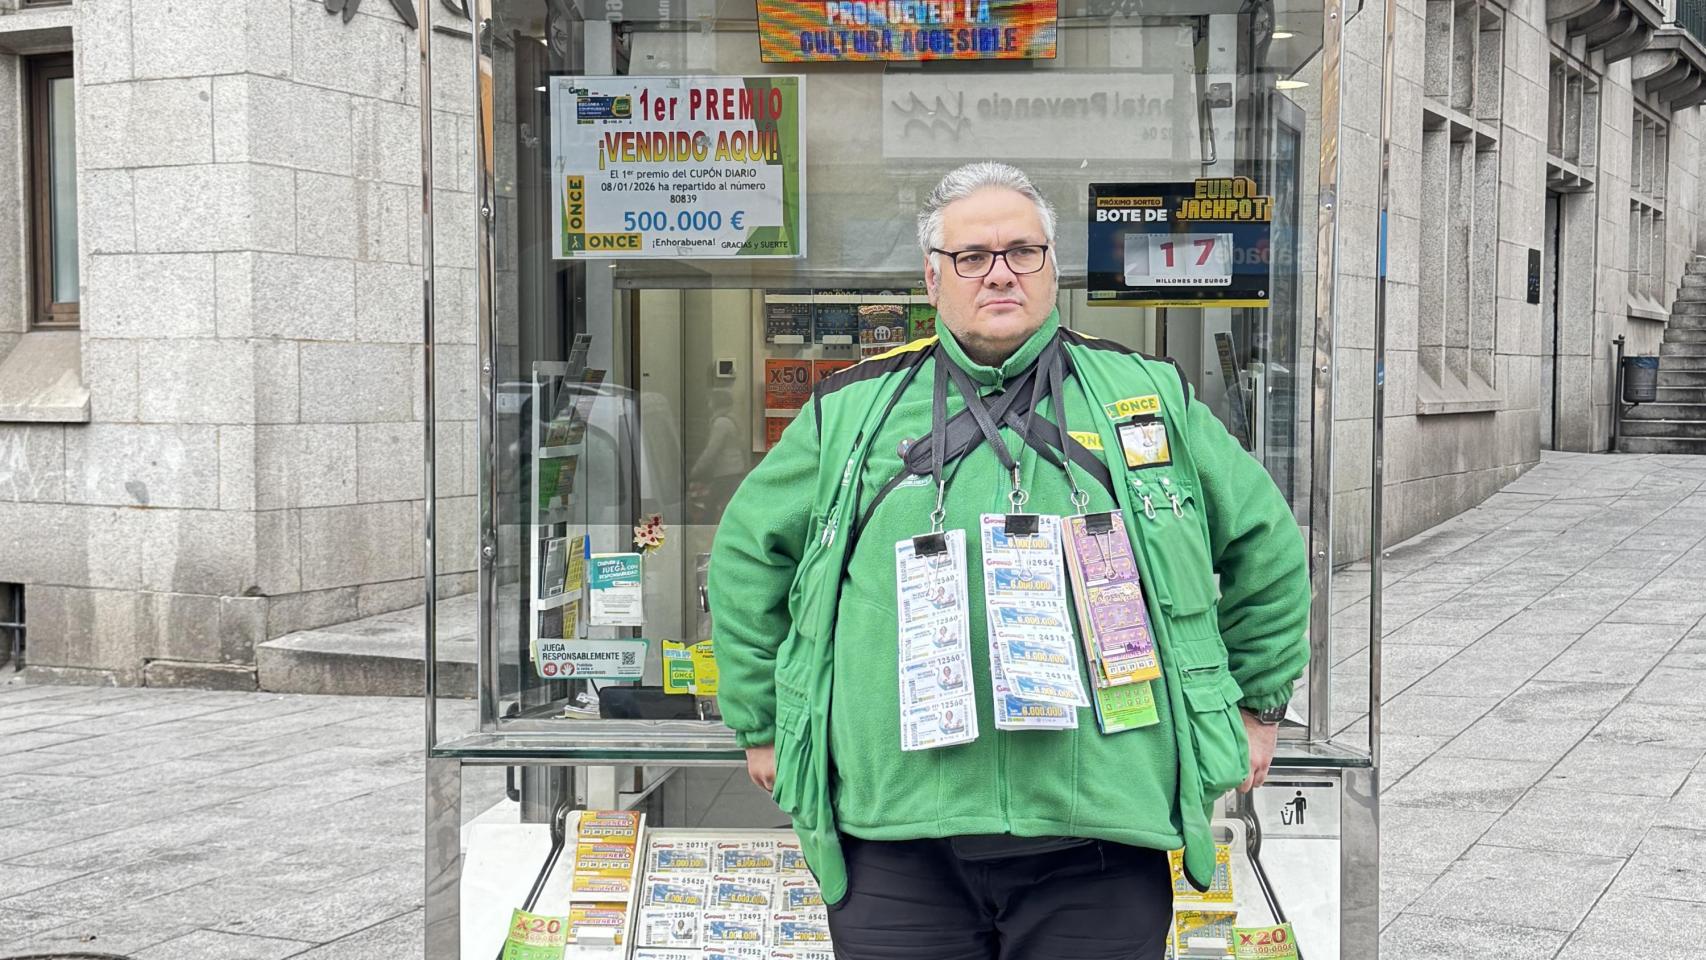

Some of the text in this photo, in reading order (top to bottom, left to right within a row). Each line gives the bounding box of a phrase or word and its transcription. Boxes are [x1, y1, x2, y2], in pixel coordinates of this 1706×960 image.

[965, 0, 990, 24] LA
[800, 27, 1018, 53] CULTURA ACCESIBLE
[640, 88, 678, 121] 1er
[690, 88, 783, 121] PREMIO
[599, 125, 778, 170] ¡VENDIDO AQUÍ!
[610, 169, 619, 179] El
[636, 169, 670, 181] premio
[672, 169, 687, 179] del
[689, 168, 722, 178] CUPÓN
[725, 168, 757, 178] DIARIO
[601, 181, 766, 194] 08/01/2026 ha repartido al número
[1195, 179, 1247, 198] EURO
[570, 178, 582, 229] ONCE
[670, 194, 697, 204] 80839
[1099, 198, 1131, 206] PRÓXIMO
[1096, 209, 1168, 222] BOTE DE
[1176, 199, 1264, 220] JACKPOT
[624, 211, 745, 232] 500.000 €
[588, 235, 638, 248] ONCE
[652, 237, 716, 248] ¡Enhorabuena!
[721, 241, 752, 249] GRACIAS
[760, 240, 788, 249] SUERTE
[1121, 398, 1157, 412] ONCE
[1076, 434, 1103, 446] ON
[542, 644, 566, 652] JUEGA
[542, 652, 620, 661] RESPONSABLEMENTE
